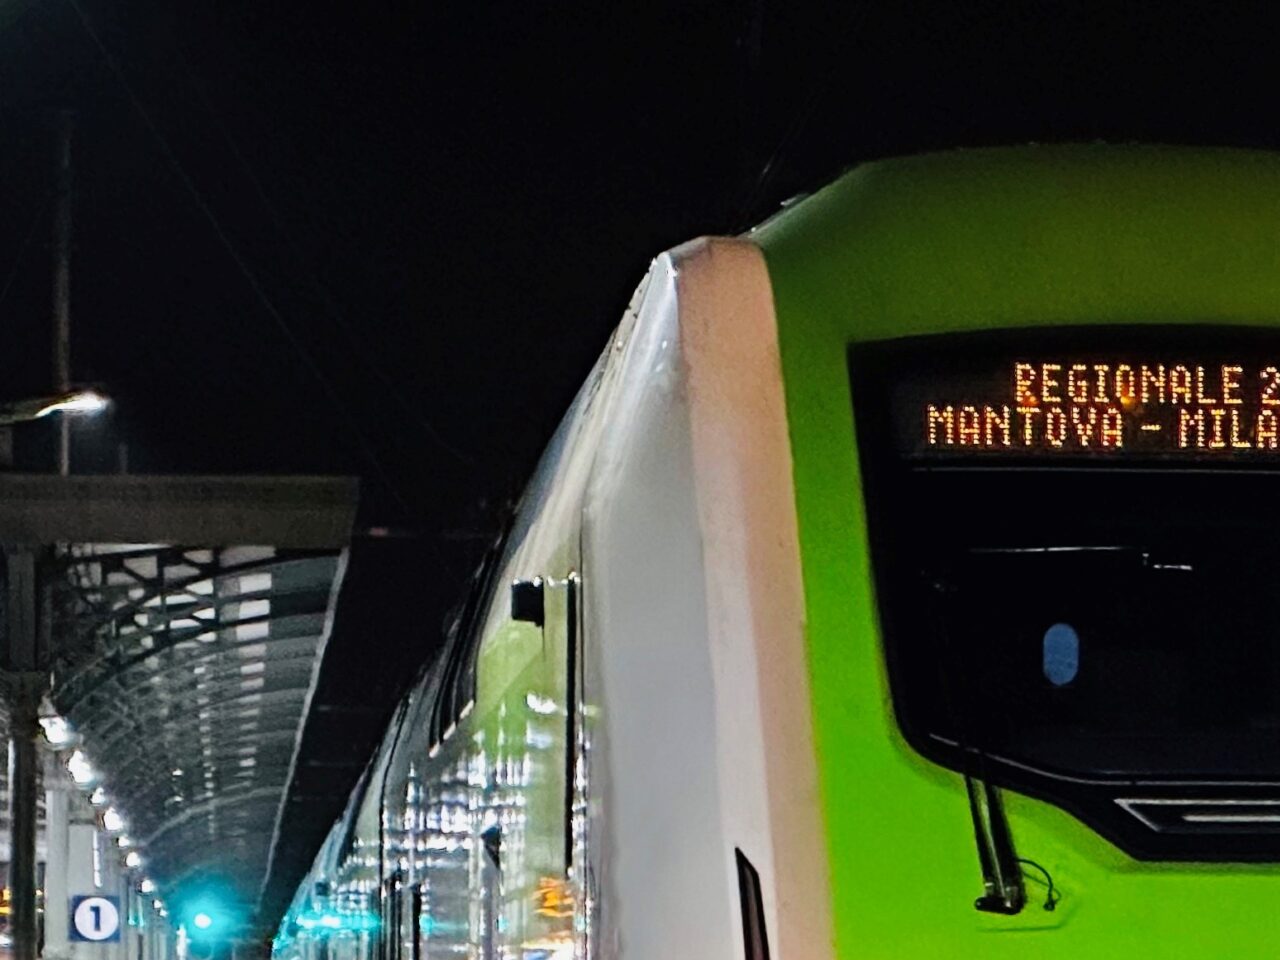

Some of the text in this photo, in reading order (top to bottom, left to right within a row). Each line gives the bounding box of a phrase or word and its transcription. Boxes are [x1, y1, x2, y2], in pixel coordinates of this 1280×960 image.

[1014, 362, 1243, 405] REGIONALE
[927, 404, 1124, 447] MANTOVA
[89, 905, 102, 932] 1
